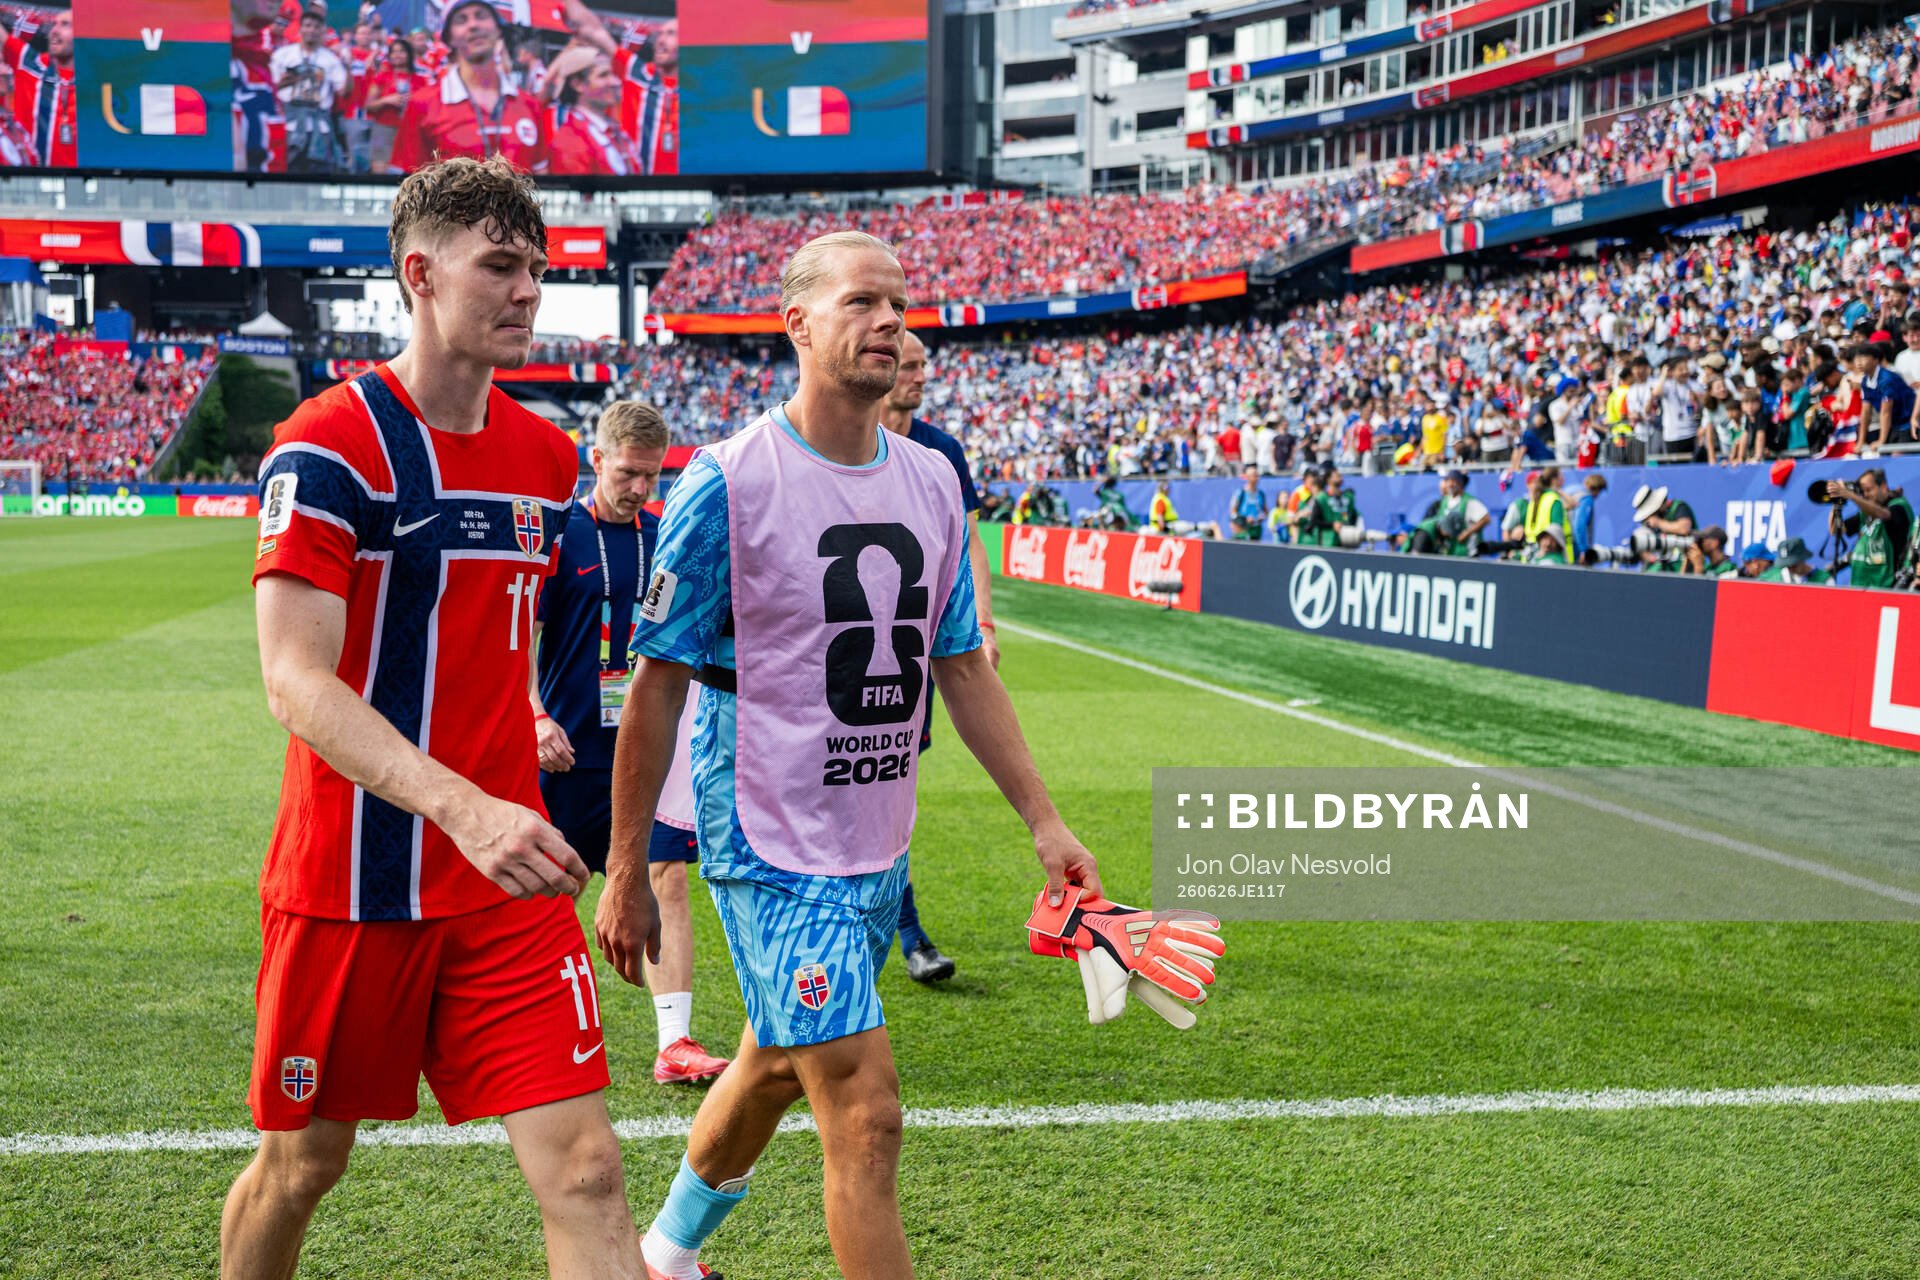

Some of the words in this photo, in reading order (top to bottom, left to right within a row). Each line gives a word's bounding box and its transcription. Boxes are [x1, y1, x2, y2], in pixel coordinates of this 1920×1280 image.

[223, 339, 287, 354] BOSTON
[36, 495, 146, 517] aramco
[193, 495, 248, 517] Coca-Cola
[1725, 500, 1788, 557] FIFA
[506, 572, 540, 651] 11
[1340, 568, 1497, 650] HYUNDAI
[861, 684, 905, 708] FIFA
[826, 735, 892, 754] WORLD
[823, 750, 911, 786] 2026
[560, 953, 600, 1031] 11
